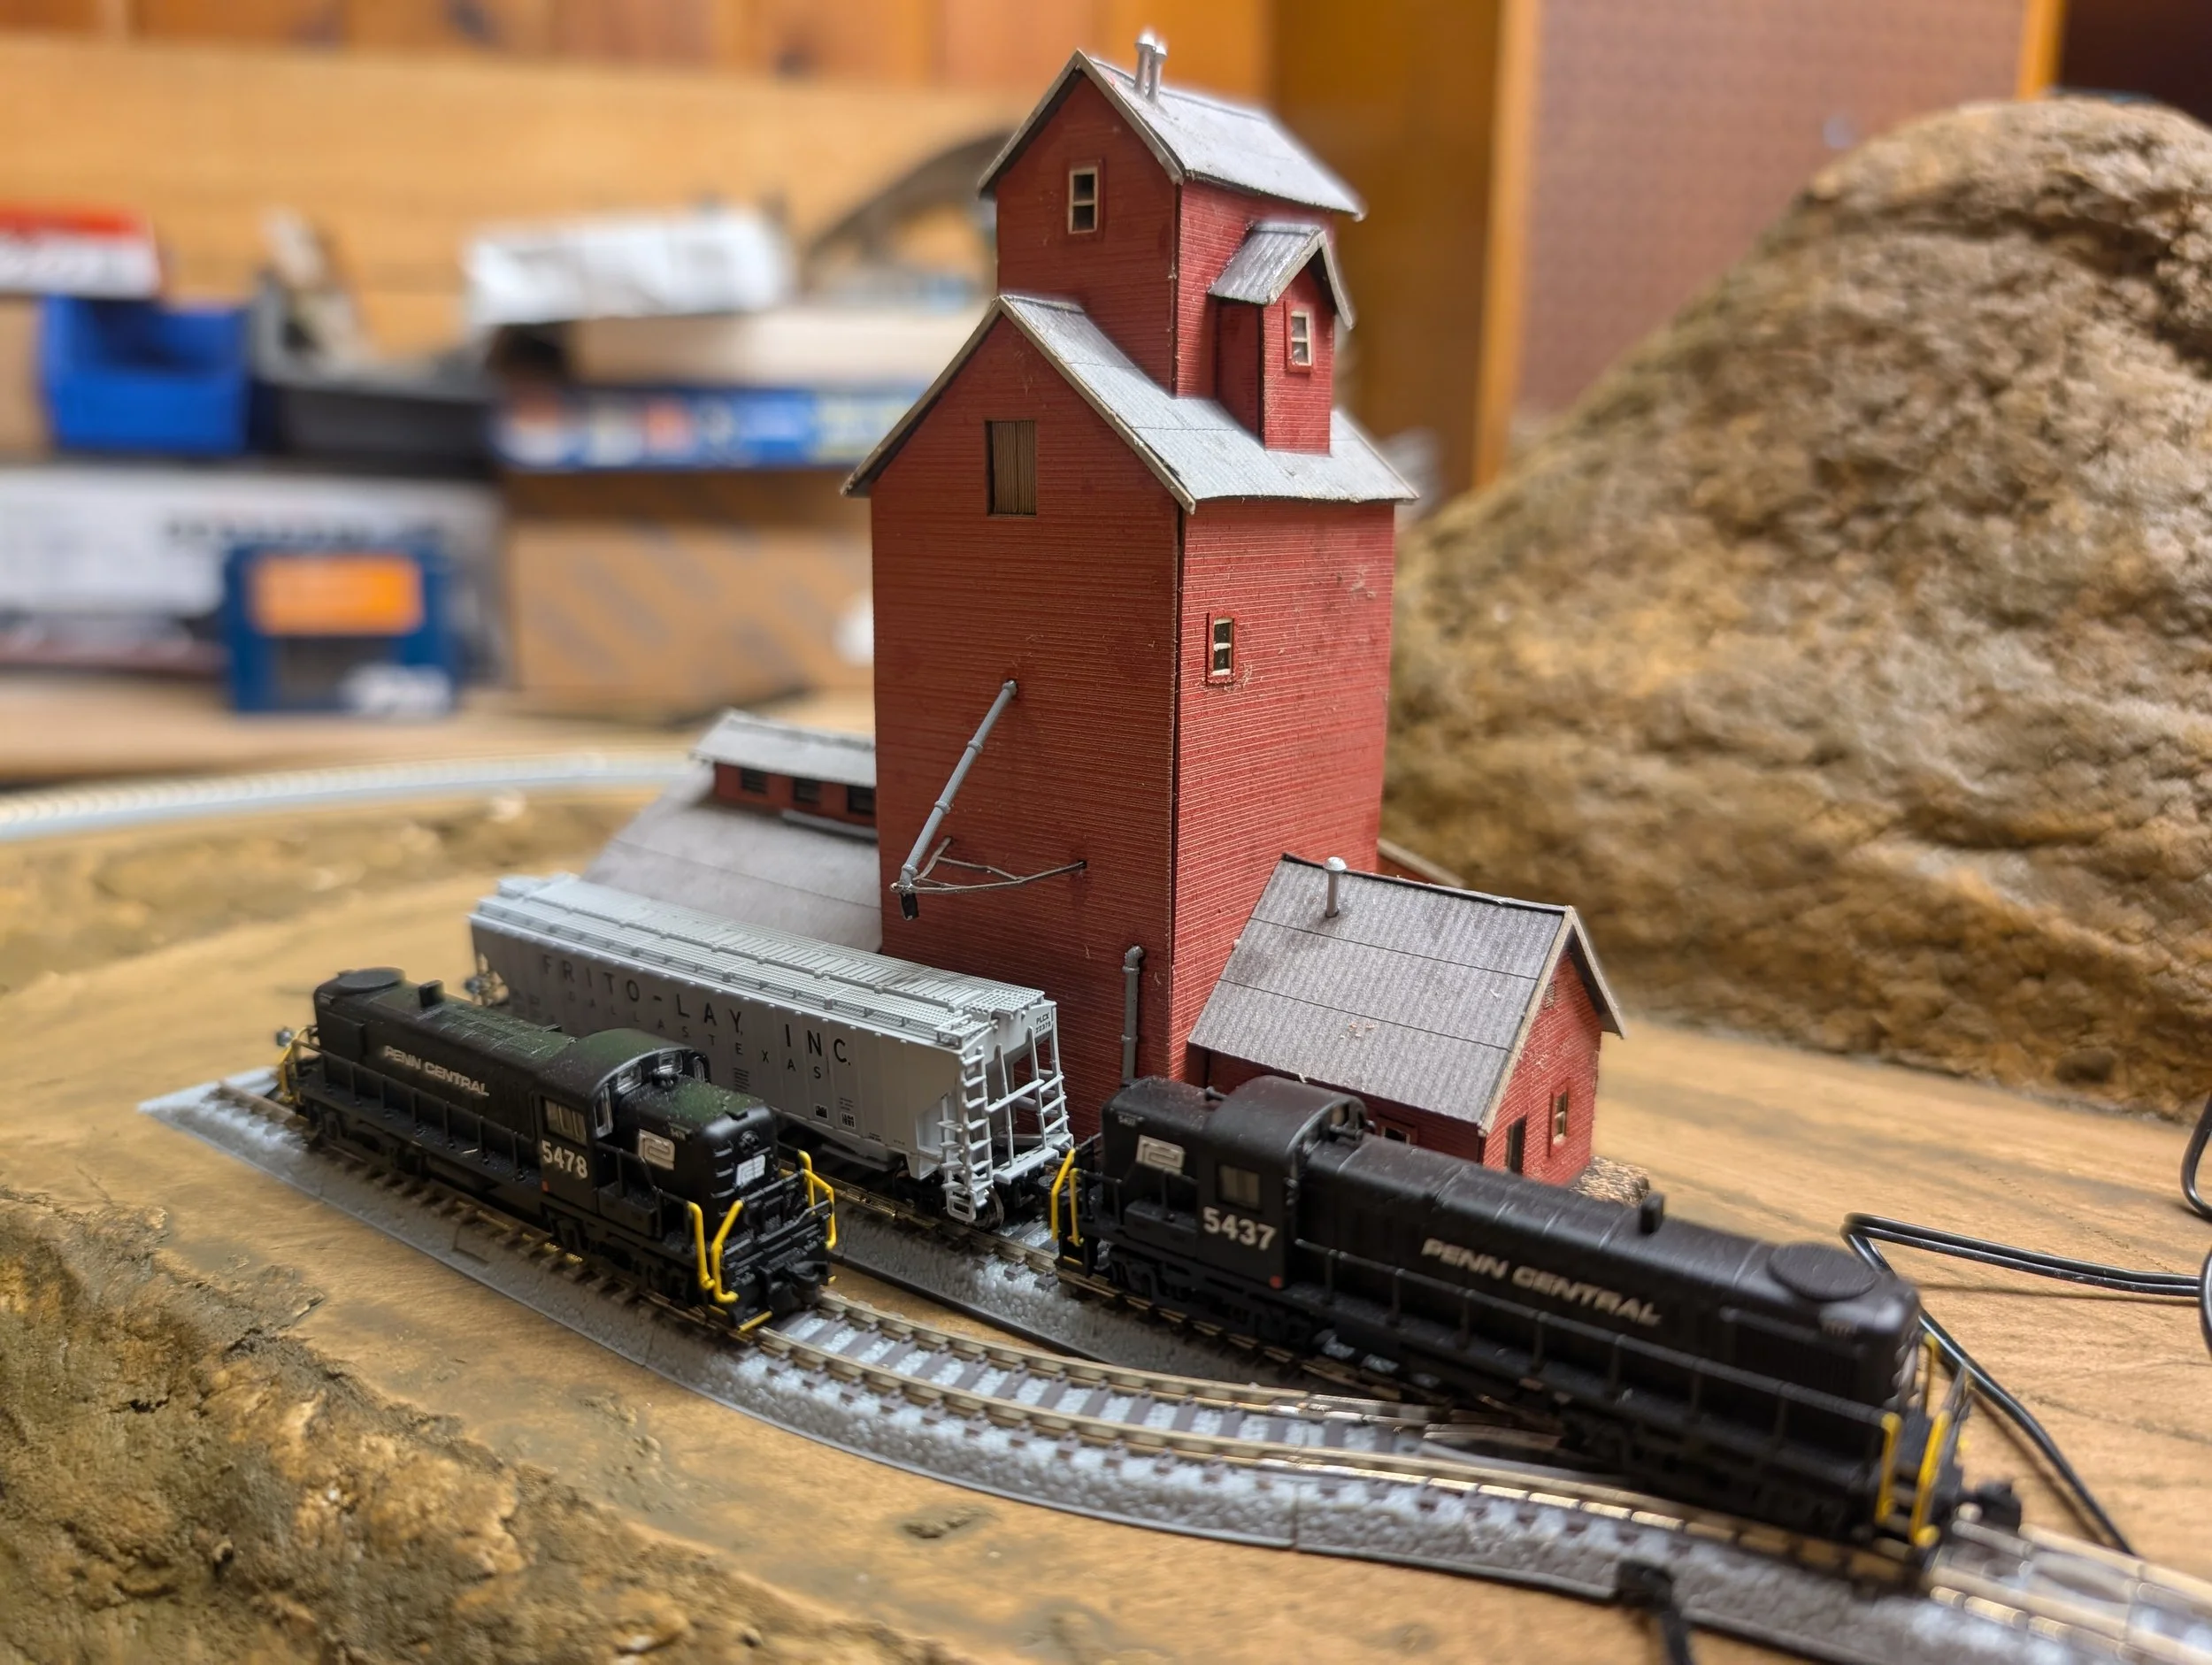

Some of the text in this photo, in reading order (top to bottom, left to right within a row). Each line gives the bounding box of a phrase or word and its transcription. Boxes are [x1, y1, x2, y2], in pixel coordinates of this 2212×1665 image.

[784, 1023, 852, 1066] INC.
[383, 1045, 490, 1097] PENN CENTRAL
[541, 1139, 589, 1179] 5478
[1202, 1206, 1277, 1251] 5437
[1421, 1238, 1663, 1327] PENN CENTRAL
